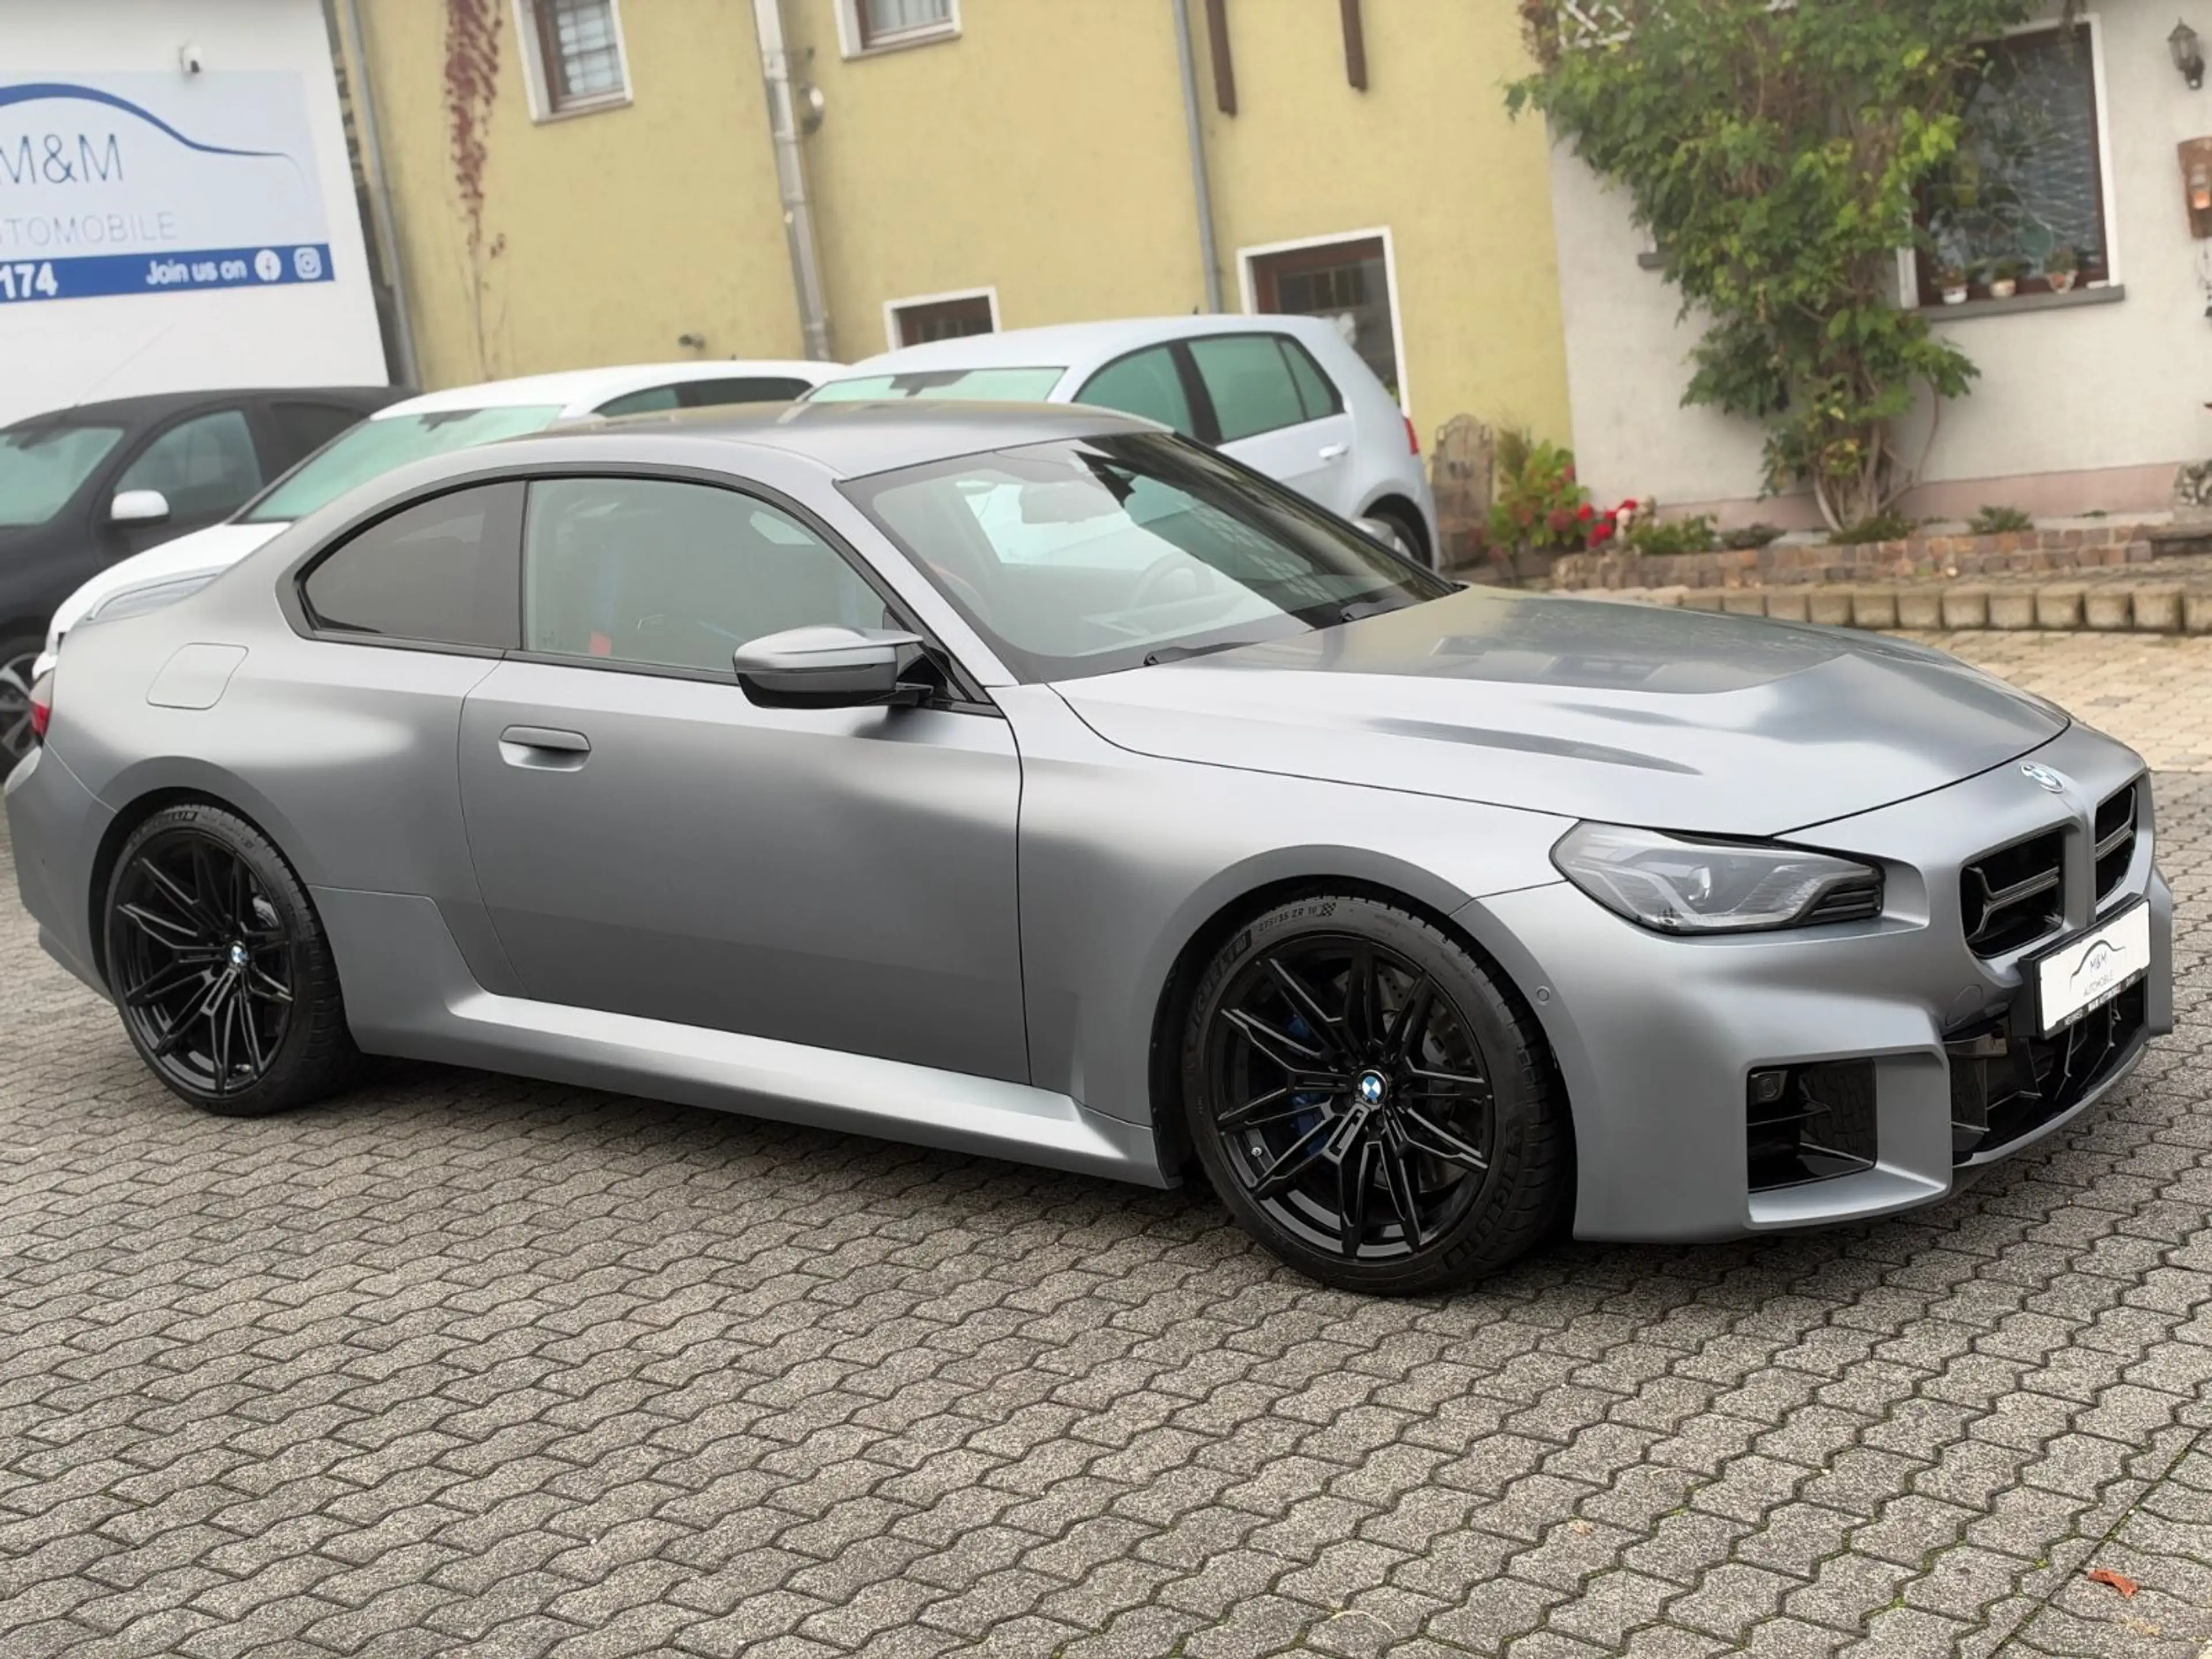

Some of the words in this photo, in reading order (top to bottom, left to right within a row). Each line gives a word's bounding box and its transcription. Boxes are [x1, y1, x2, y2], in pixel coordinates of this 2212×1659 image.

[0, 133, 123, 184] M&M
[0, 211, 177, 247] TOMOBILE
[0, 261, 59, 300] 174
[145, 259, 188, 286] Join
[192, 263, 218, 282] us
[221, 259, 247, 280] on
